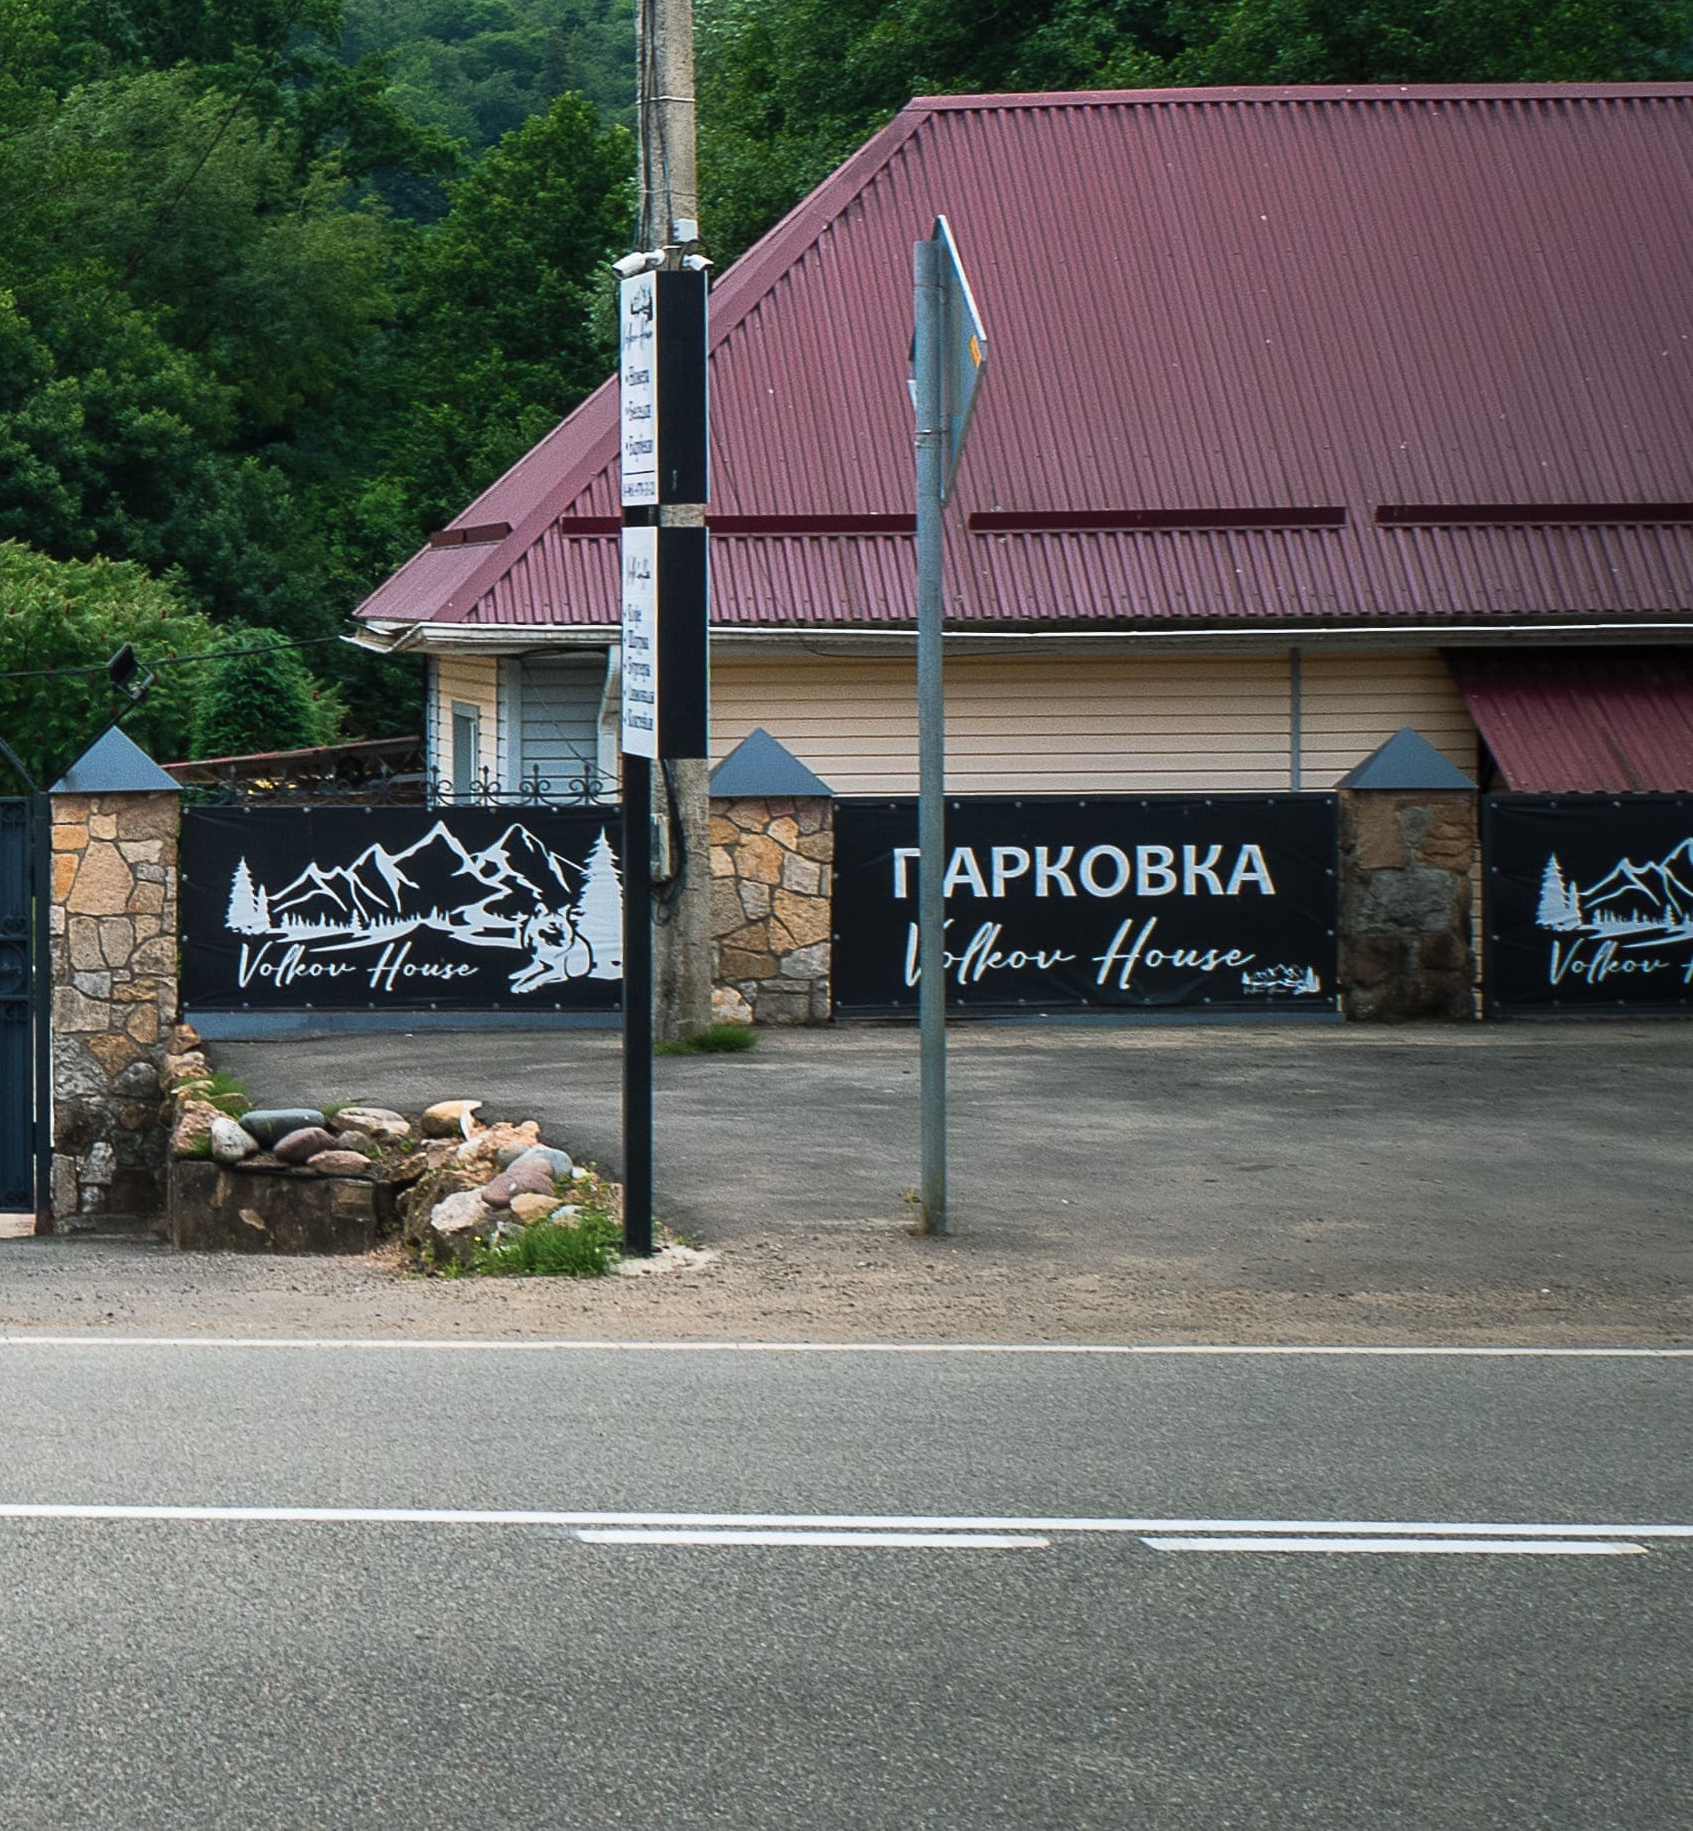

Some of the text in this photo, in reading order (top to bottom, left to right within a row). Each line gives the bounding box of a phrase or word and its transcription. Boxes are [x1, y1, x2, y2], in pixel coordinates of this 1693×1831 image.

[238, 940, 480, 991] Volkov House
[1091, 916, 1256, 990] House
[1549, 938, 1671, 985] Volkov
